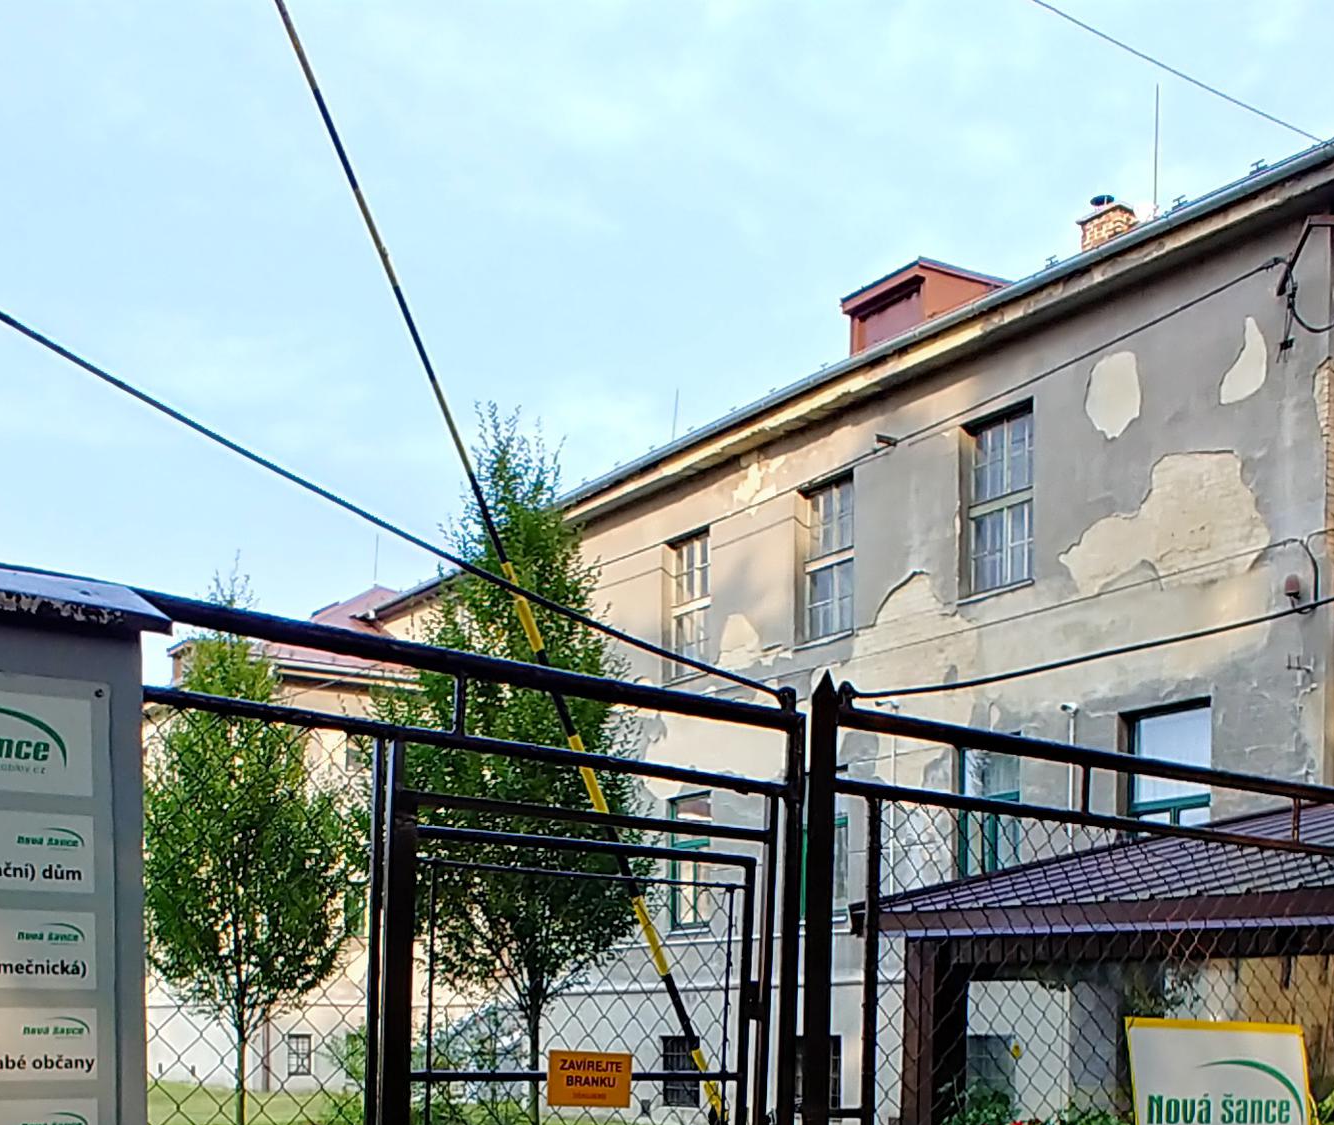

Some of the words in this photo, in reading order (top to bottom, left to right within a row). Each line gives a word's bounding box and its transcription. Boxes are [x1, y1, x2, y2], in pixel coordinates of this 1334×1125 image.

[42, 864, 82, 881] dům
[32, 1054, 95, 1073] občany
[559, 1057, 623, 1073] ZAVÍREJTE
[566, 1075, 617, 1088] BRANKU
[1146, 1093, 1211, 1125] Nová
[1220, 1093, 1291, 1125] šance
